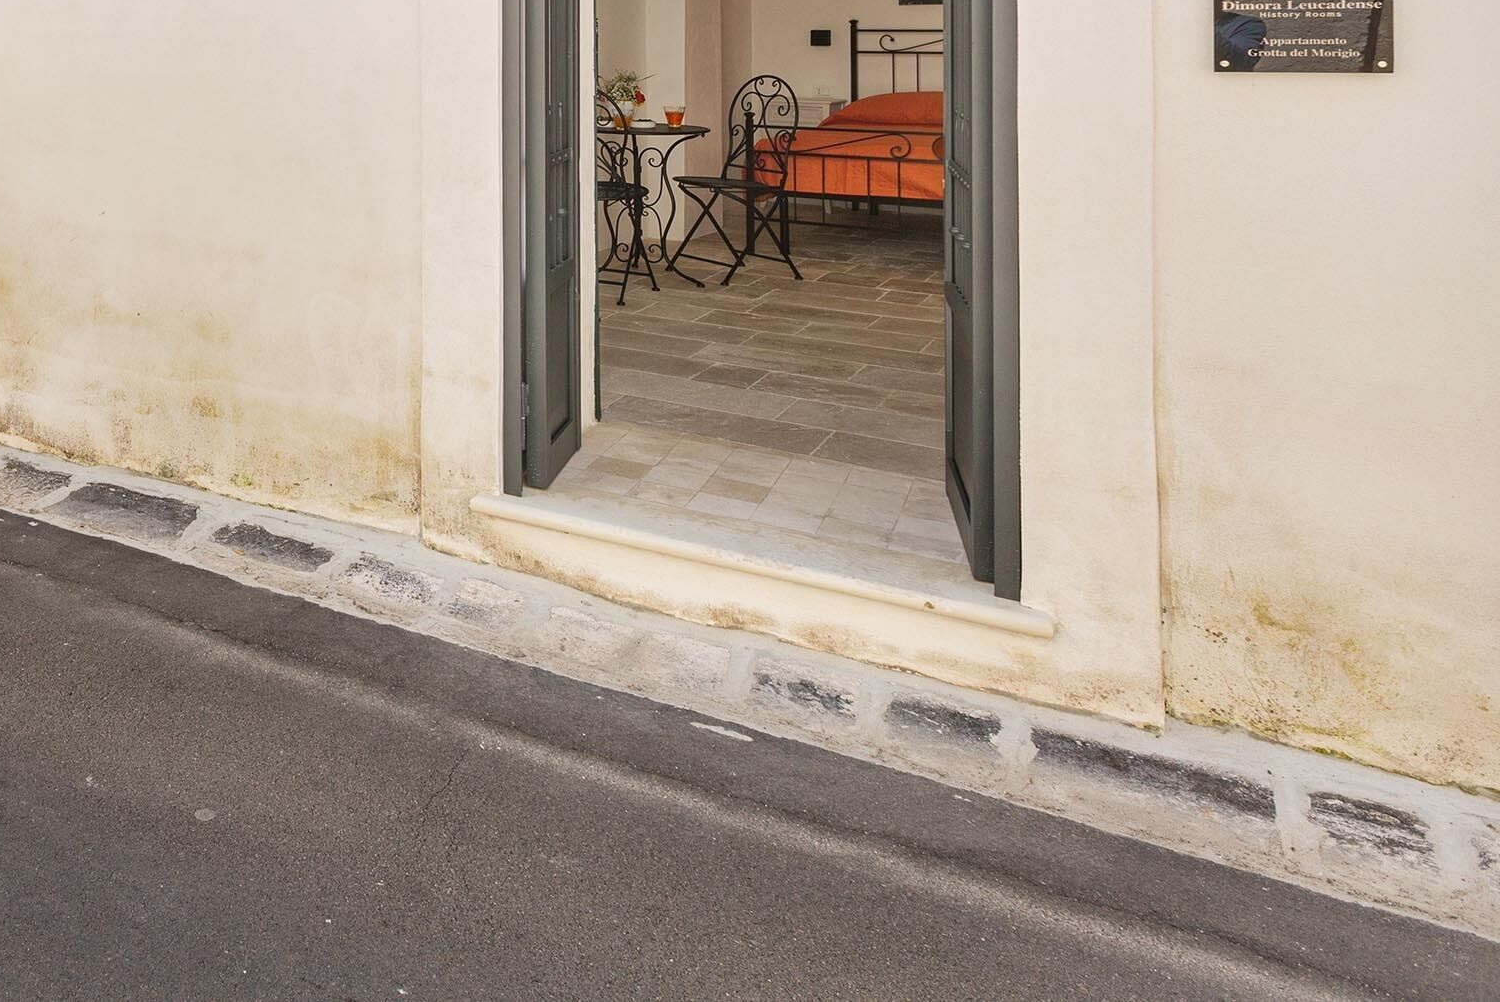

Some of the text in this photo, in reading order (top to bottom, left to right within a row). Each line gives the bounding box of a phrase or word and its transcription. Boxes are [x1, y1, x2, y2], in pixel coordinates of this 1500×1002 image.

[1222, 0, 1383, 11] Dimora Leucadense
[1259, 11, 1301, 19] History
[1260, 37, 1347, 47] Appartamento
[1247, 48, 1360, 58] Grotta del Morigio
